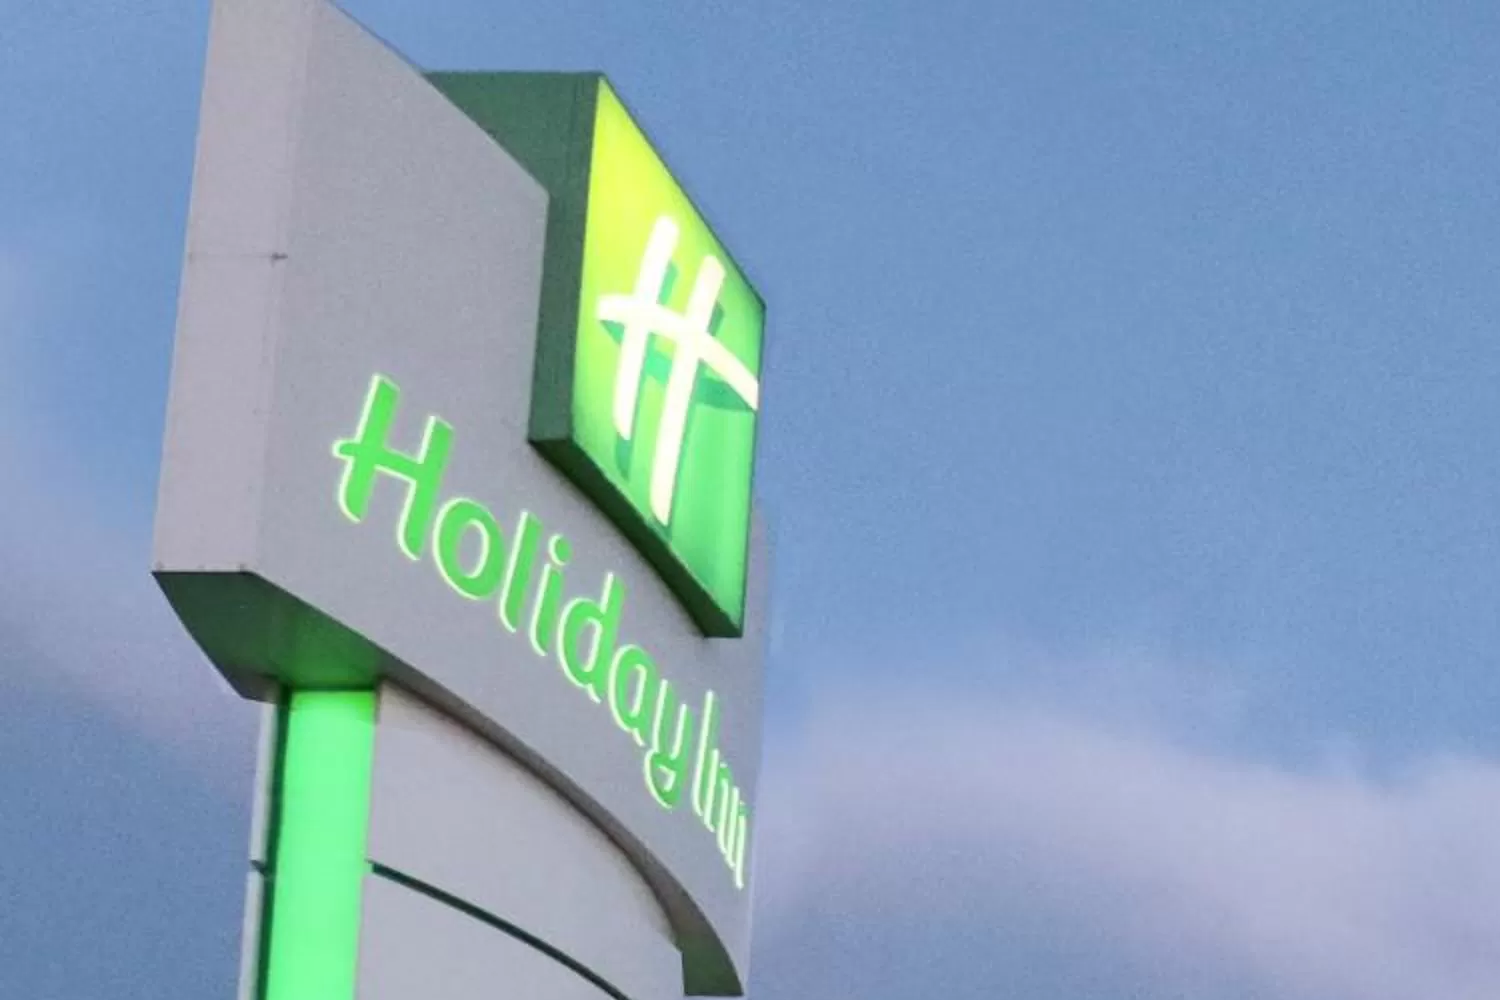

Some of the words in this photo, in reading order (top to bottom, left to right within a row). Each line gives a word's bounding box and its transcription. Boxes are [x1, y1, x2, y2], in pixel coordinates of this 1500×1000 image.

[594, 213, 759, 527] H
[331, 372, 694, 811] Holiday
[691, 689, 748, 889] Inn
